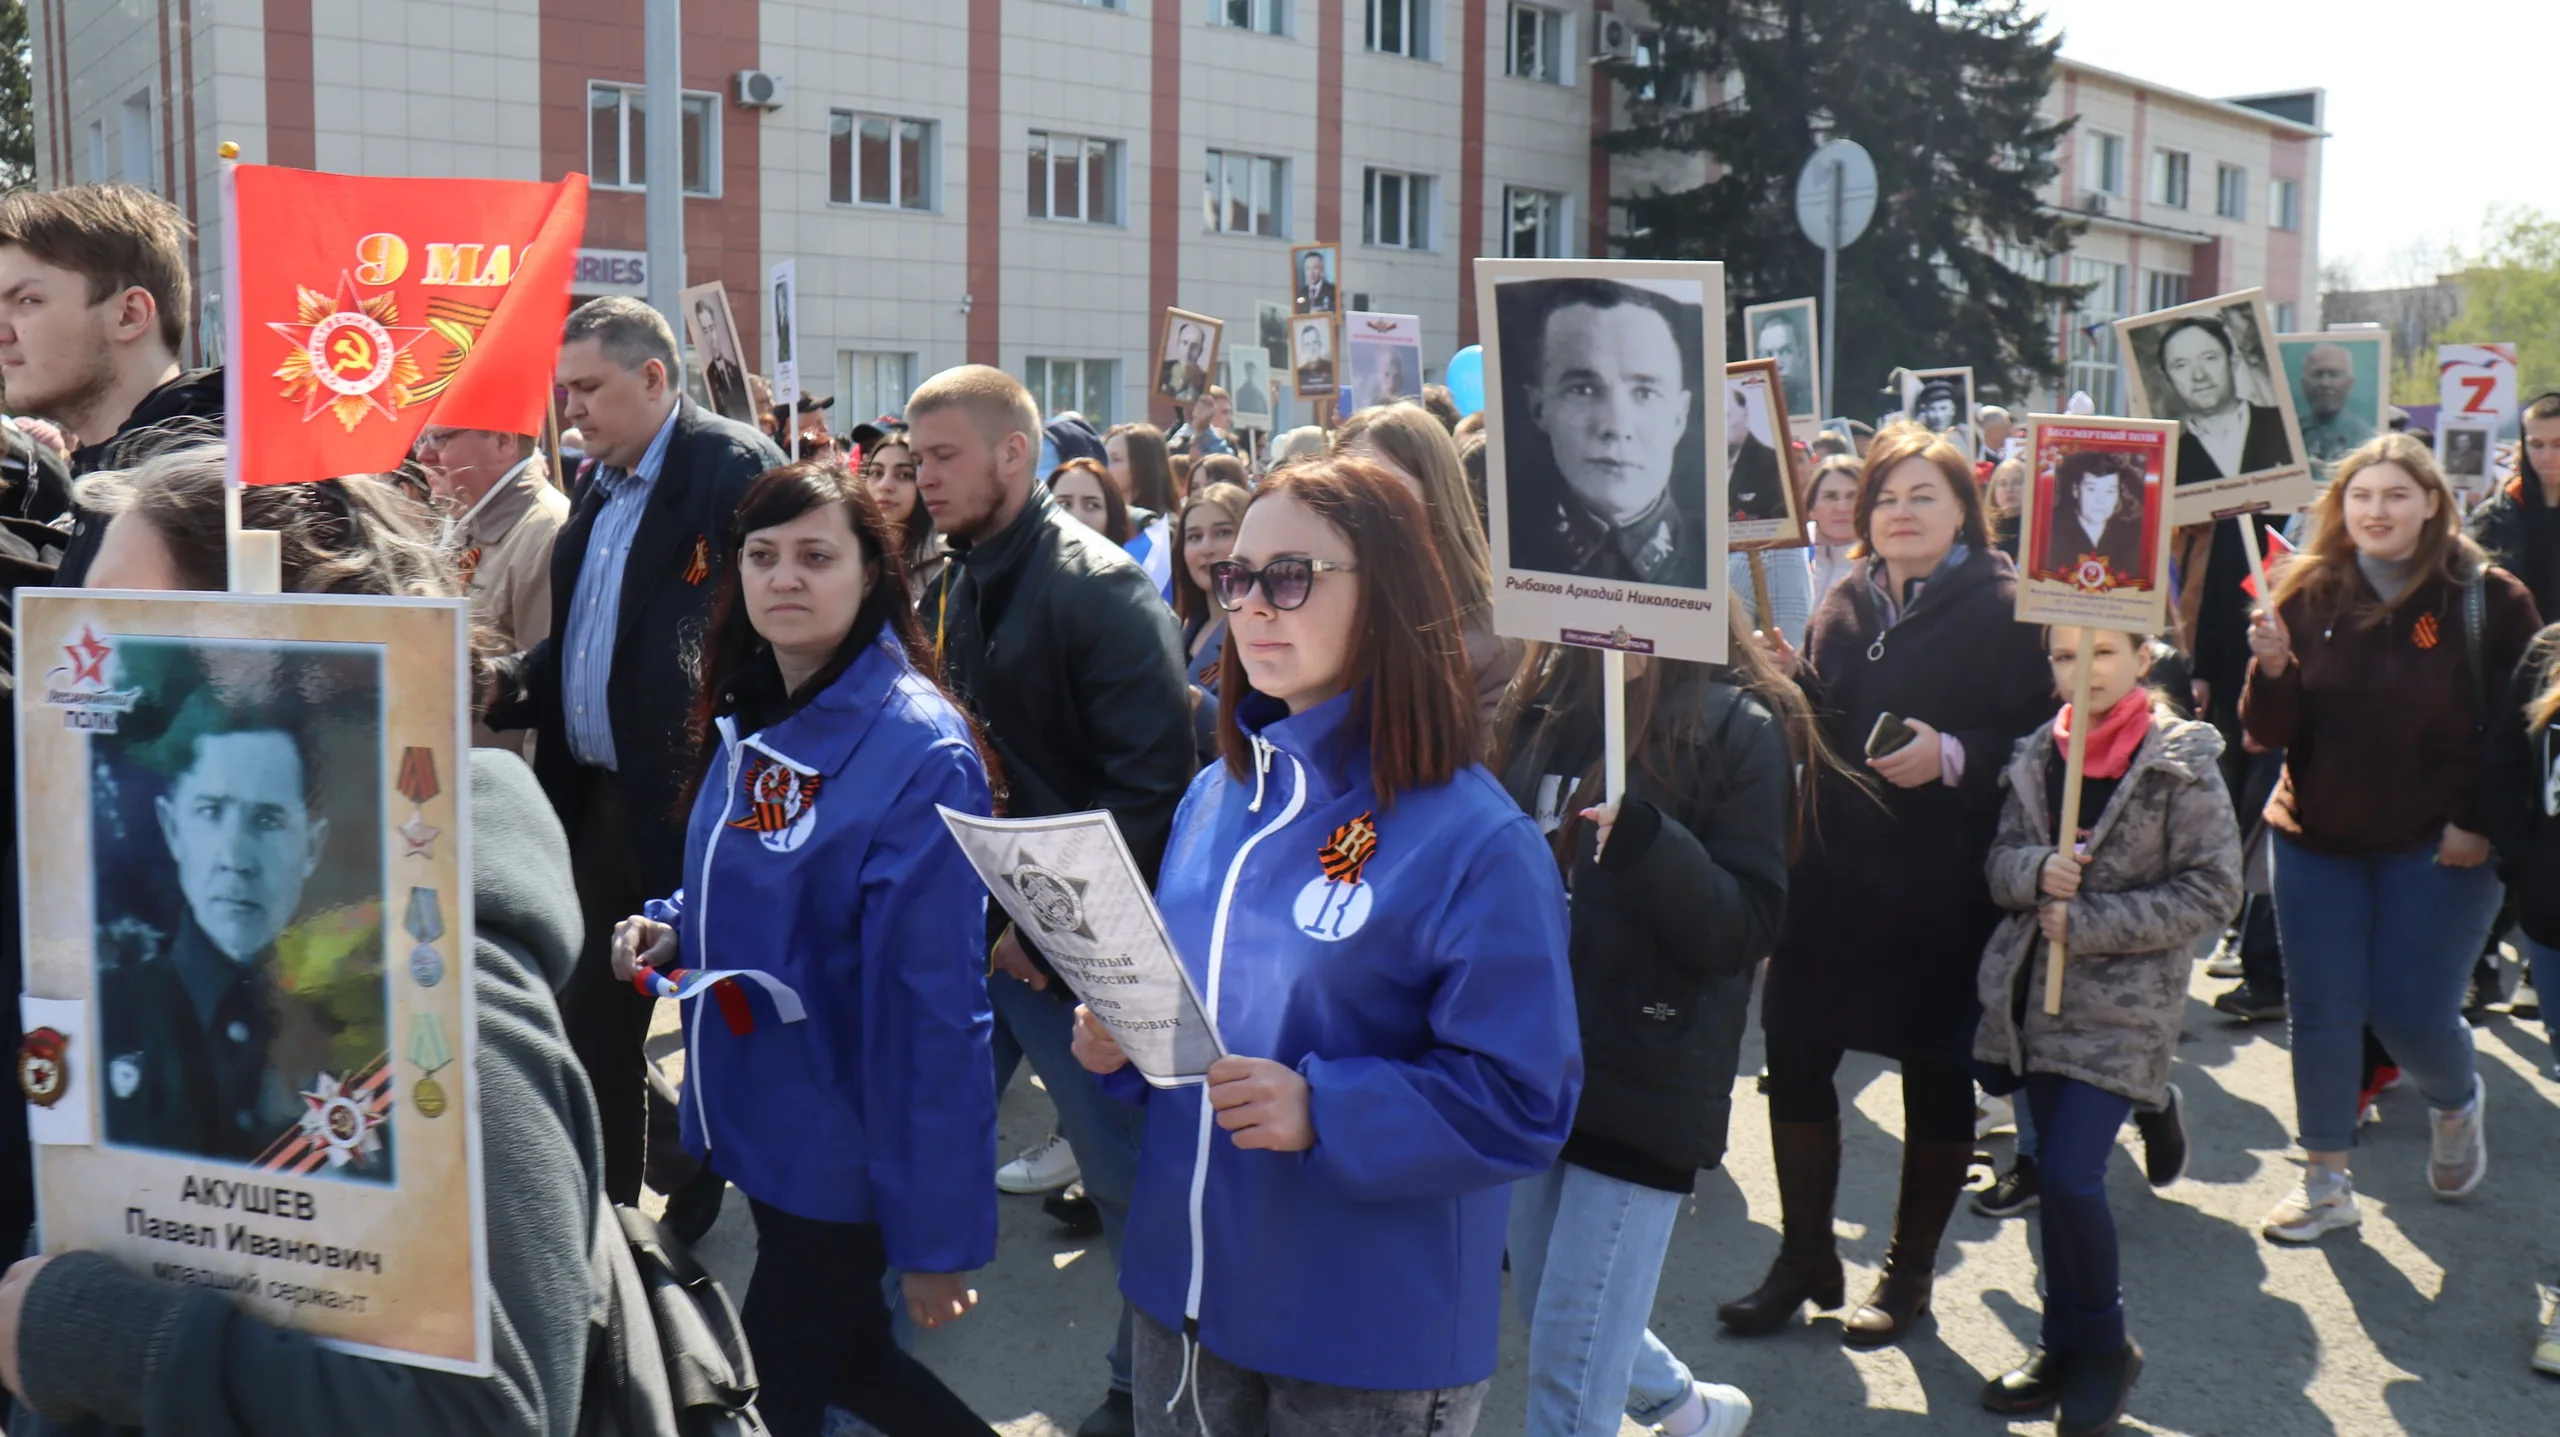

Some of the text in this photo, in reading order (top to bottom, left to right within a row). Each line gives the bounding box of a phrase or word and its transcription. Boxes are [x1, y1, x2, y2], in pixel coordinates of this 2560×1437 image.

[355, 232, 409, 286] 9
[2460, 375, 2498, 415] Z
[1505, 576, 1713, 612] Рыбаков Аркадий Николаевич
[1082, 970, 1140, 986] России
[1108, 1014, 1182, 1032] Егорович
[181, 1174, 317, 1222] АКУШЕВ
[125, 1205, 383, 1275] Павел Иванович
[152, 1260, 370, 1314] младший сержант
